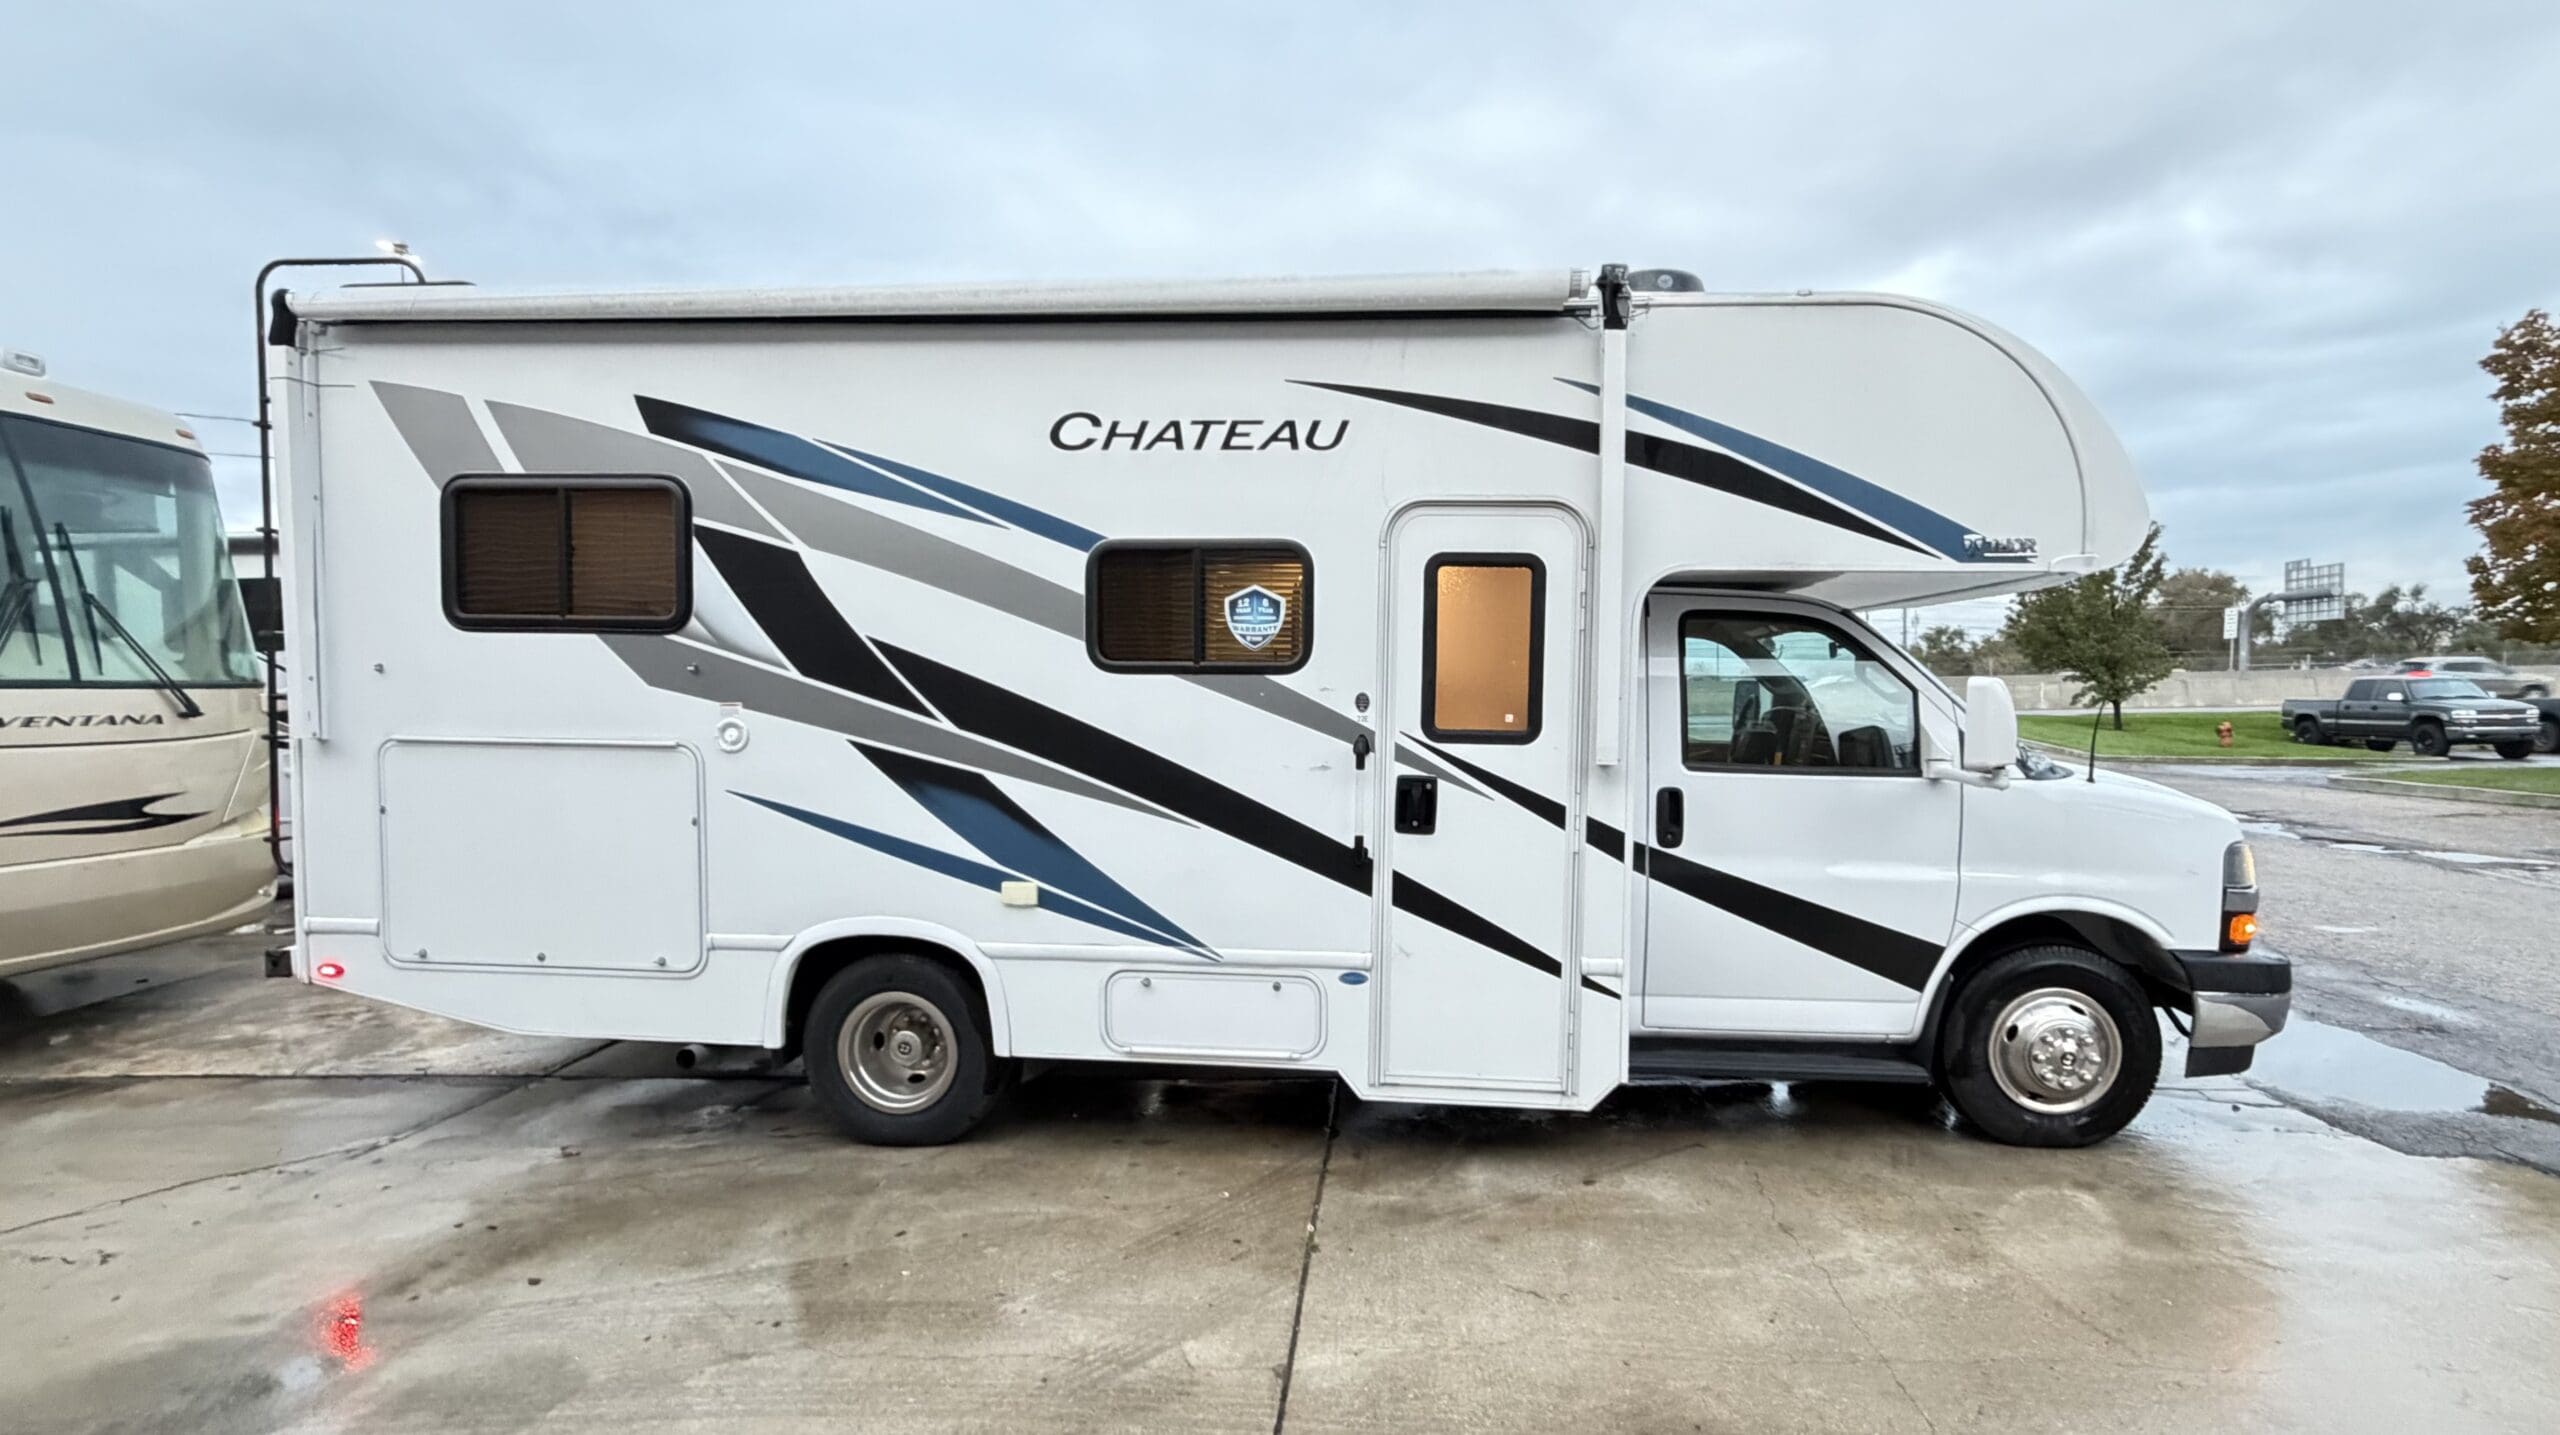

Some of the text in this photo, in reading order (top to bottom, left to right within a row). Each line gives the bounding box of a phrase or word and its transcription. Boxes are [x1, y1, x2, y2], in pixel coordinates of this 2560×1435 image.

[1049, 411, 1350, 451] CHATEAU
[1232, 625, 1277, 633] WARRANTY
[0, 714, 164, 728] VENTANA
